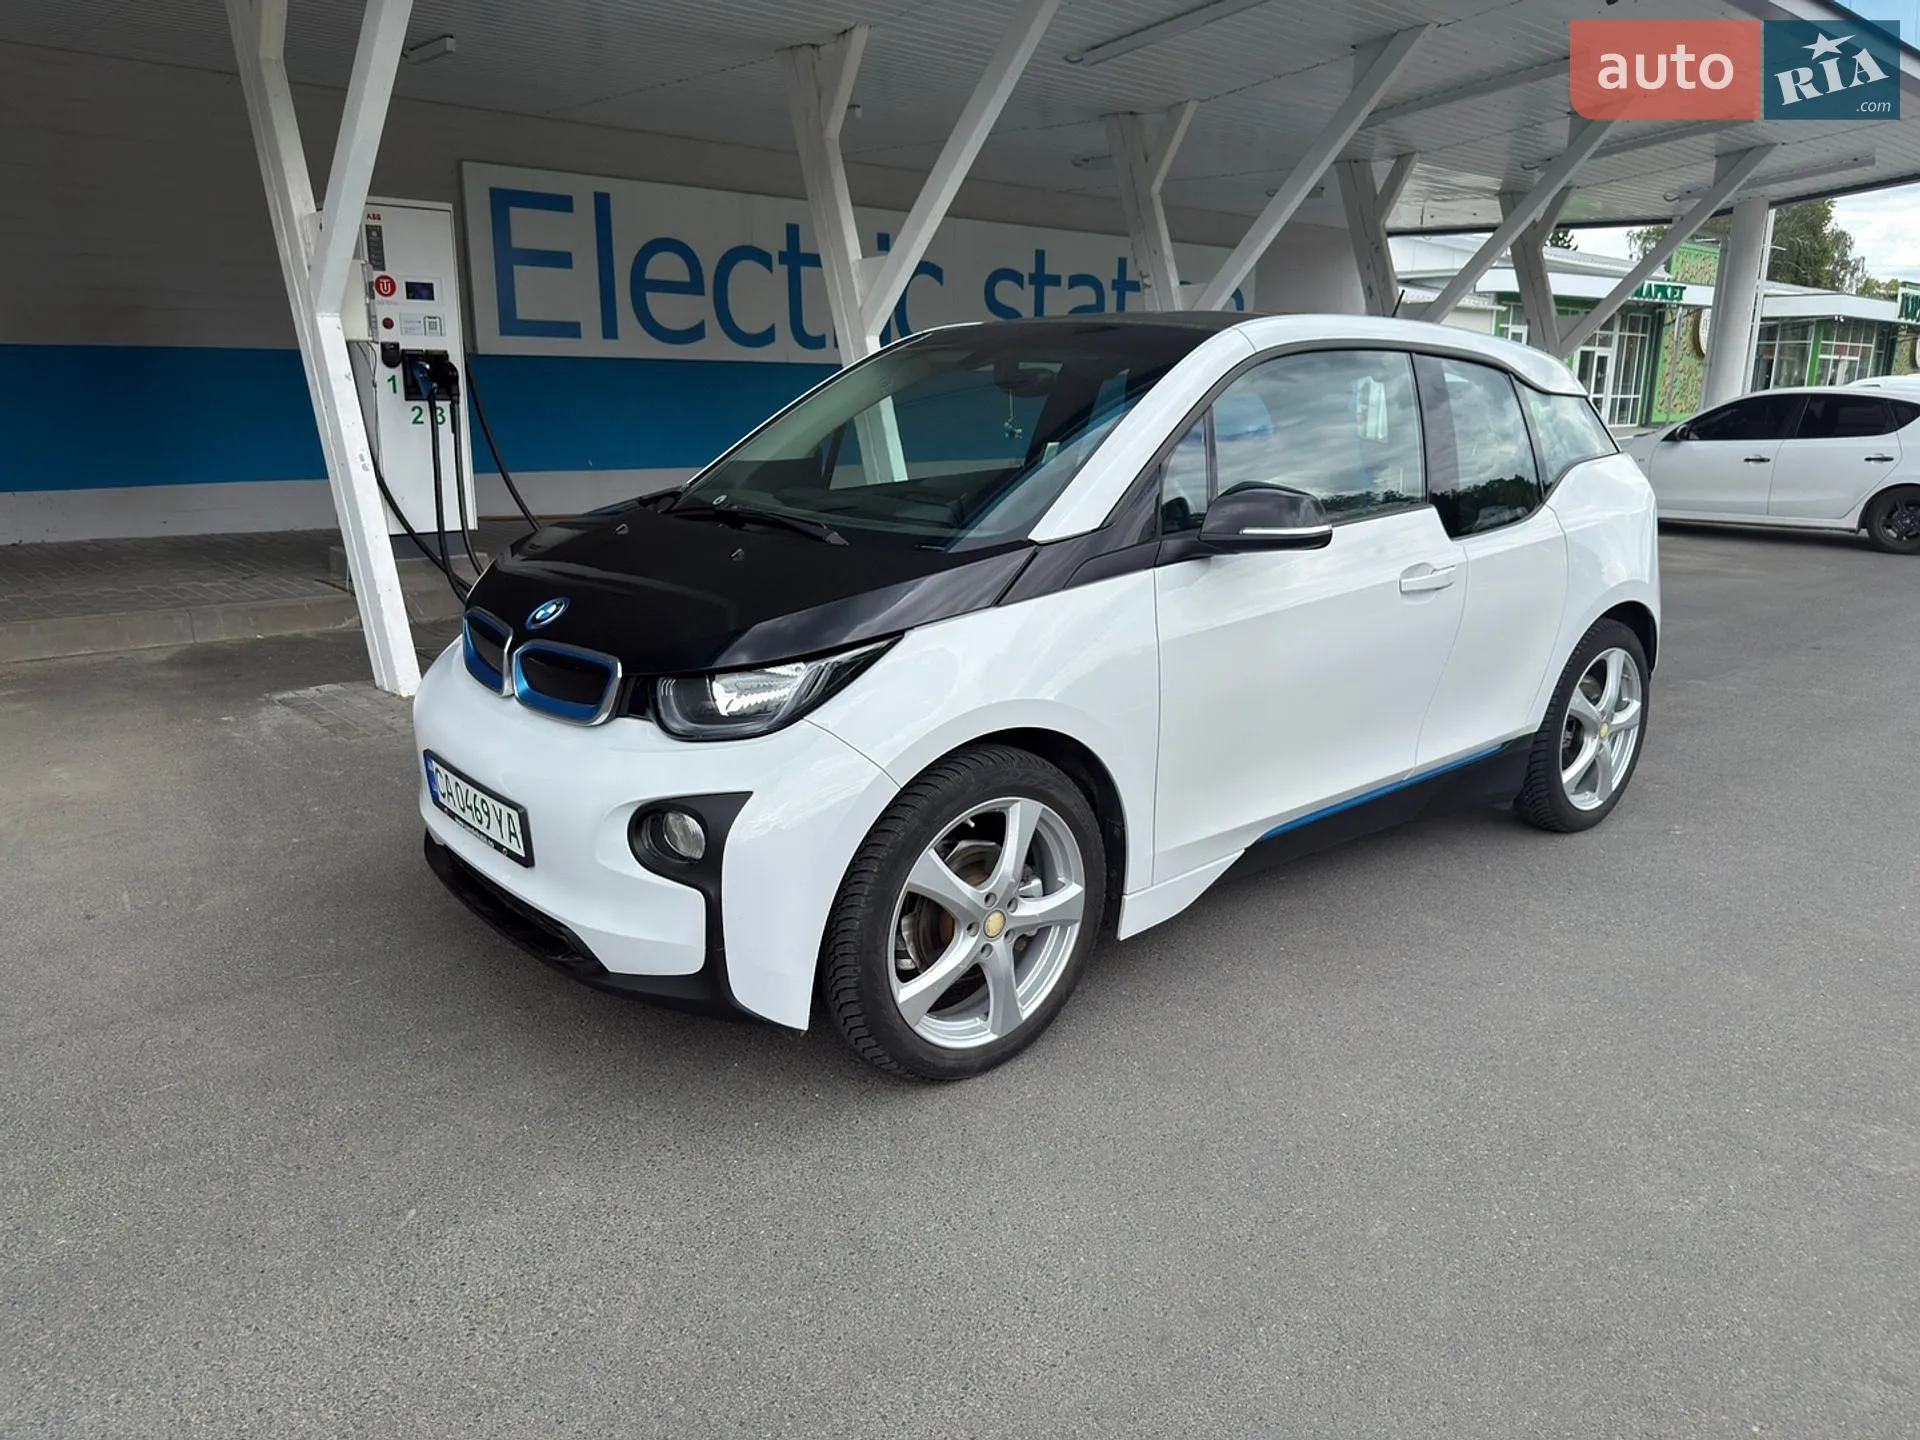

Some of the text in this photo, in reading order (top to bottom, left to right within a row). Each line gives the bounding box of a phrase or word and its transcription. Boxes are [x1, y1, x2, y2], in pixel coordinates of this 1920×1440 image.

[387, 374, 397, 394] 1
[411, 406, 446, 425] 2 3
